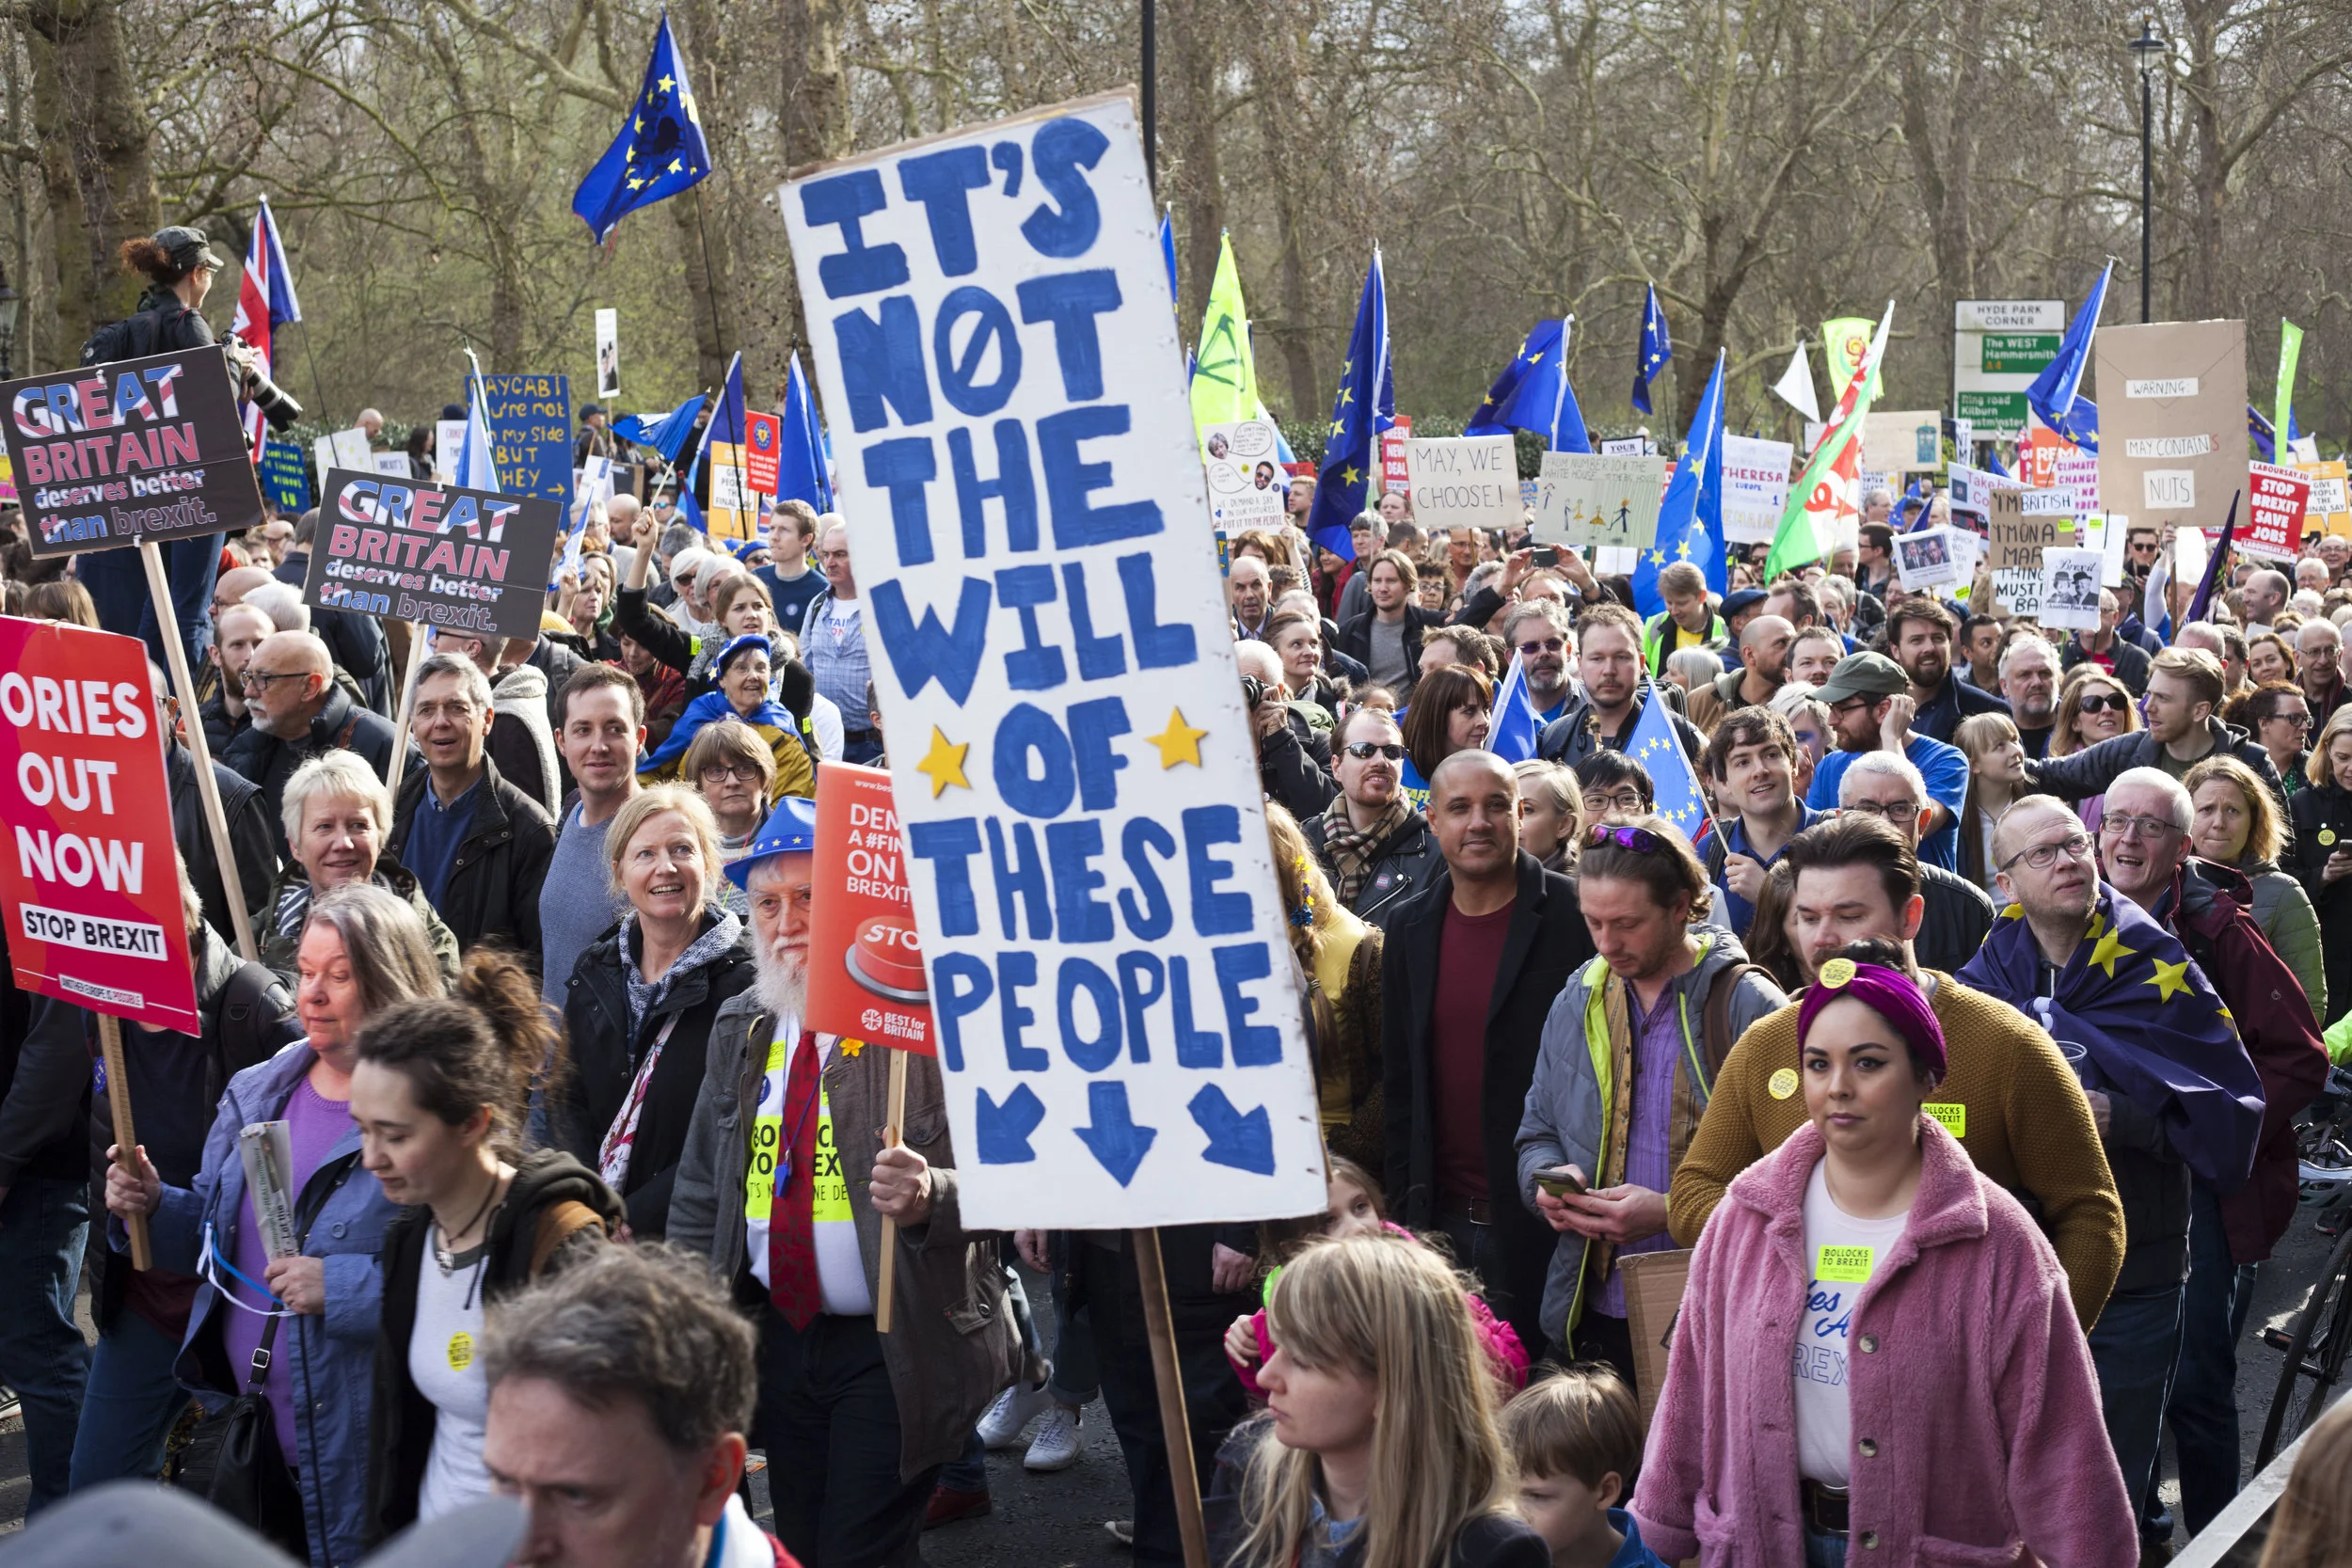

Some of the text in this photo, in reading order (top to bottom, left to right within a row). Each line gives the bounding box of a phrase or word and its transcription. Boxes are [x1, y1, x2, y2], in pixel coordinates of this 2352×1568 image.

[800, 117, 1110, 299] IT'S
[1978, 305, 2042, 314] HYDE PARK
[1985, 316, 2034, 325] CORNER
[1985, 338, 2038, 348] The WEST
[1985, 349, 2057, 360] Hammersmith
[2134, 381, 2190, 394] WARNING:
[12, 364, 183, 439] GREAT
[1987, 395, 2010, 404] road
[1962, 406, 1997, 415] Kilburn
[1967, 418, 2024, 428] estminster
[23, 422, 200, 484] BRITAIN
[496, 446, 538, 464] BUT
[1610, 444, 1635, 453] YOUR
[2129, 442, 2152, 454] MAY
[1387, 462, 1407, 475] DEAL
[1416, 446, 1502, 476] MAY, WE
[1546, 458, 1568, 467] FROM
[1571, 457, 1609, 470] NUMBER
[2058, 461, 2096, 470] CLIMATE
[501, 468, 541, 488] HEY
[2058, 474, 2097, 483] CHANGE
[2253, 463, 2309, 481] LABOURSAY.EU
[34, 469, 205, 509] deserves better
[863, 404, 1165, 567] THE
[2150, 477, 2190, 502] NUTS
[2261, 479, 2296, 497] STOP
[1418, 484, 1503, 509] CHOOSE!
[2251, 493, 2299, 515] BREXIT
[40, 496, 217, 544] than brexit.
[338, 480, 520, 543] GREAT
[1723, 509, 1775, 530] EMAIN
[2255, 510, 2289, 529] SAVE
[2251, 526, 2286, 545] JOBS
[328, 524, 510, 581] BRITAIN
[2003, 546, 2043, 564] MAR
[2056, 559, 2096, 572] Brexit
[326, 559, 503, 602] deserves better
[1996, 583, 2036, 597] MUST
[320, 581, 498, 632] than brexit.
[869, 552, 1198, 707] WILL
[1, 672, 147, 739] ORIES
[993, 696, 1132, 818] OF
[18, 752, 119, 815] OUT
[848, 830, 863, 846] A
[15, 826, 143, 895] NOW
[848, 849, 897, 881] ON
[908, 805, 1253, 942] THESE
[848, 876, 911, 903] BREXIT
[25, 911, 160, 954] STOP BREXIT
[864, 924, 921, 950] STO
[932, 942, 1282, 1073] PEOPLE
[884, 1012, 926, 1029] BEST for
[883, 1023, 924, 1041] BRITAIN
[1825, 1248, 1868, 1258] BOLLOCKS
[1836, 1258, 1867, 1266] BREXIT
